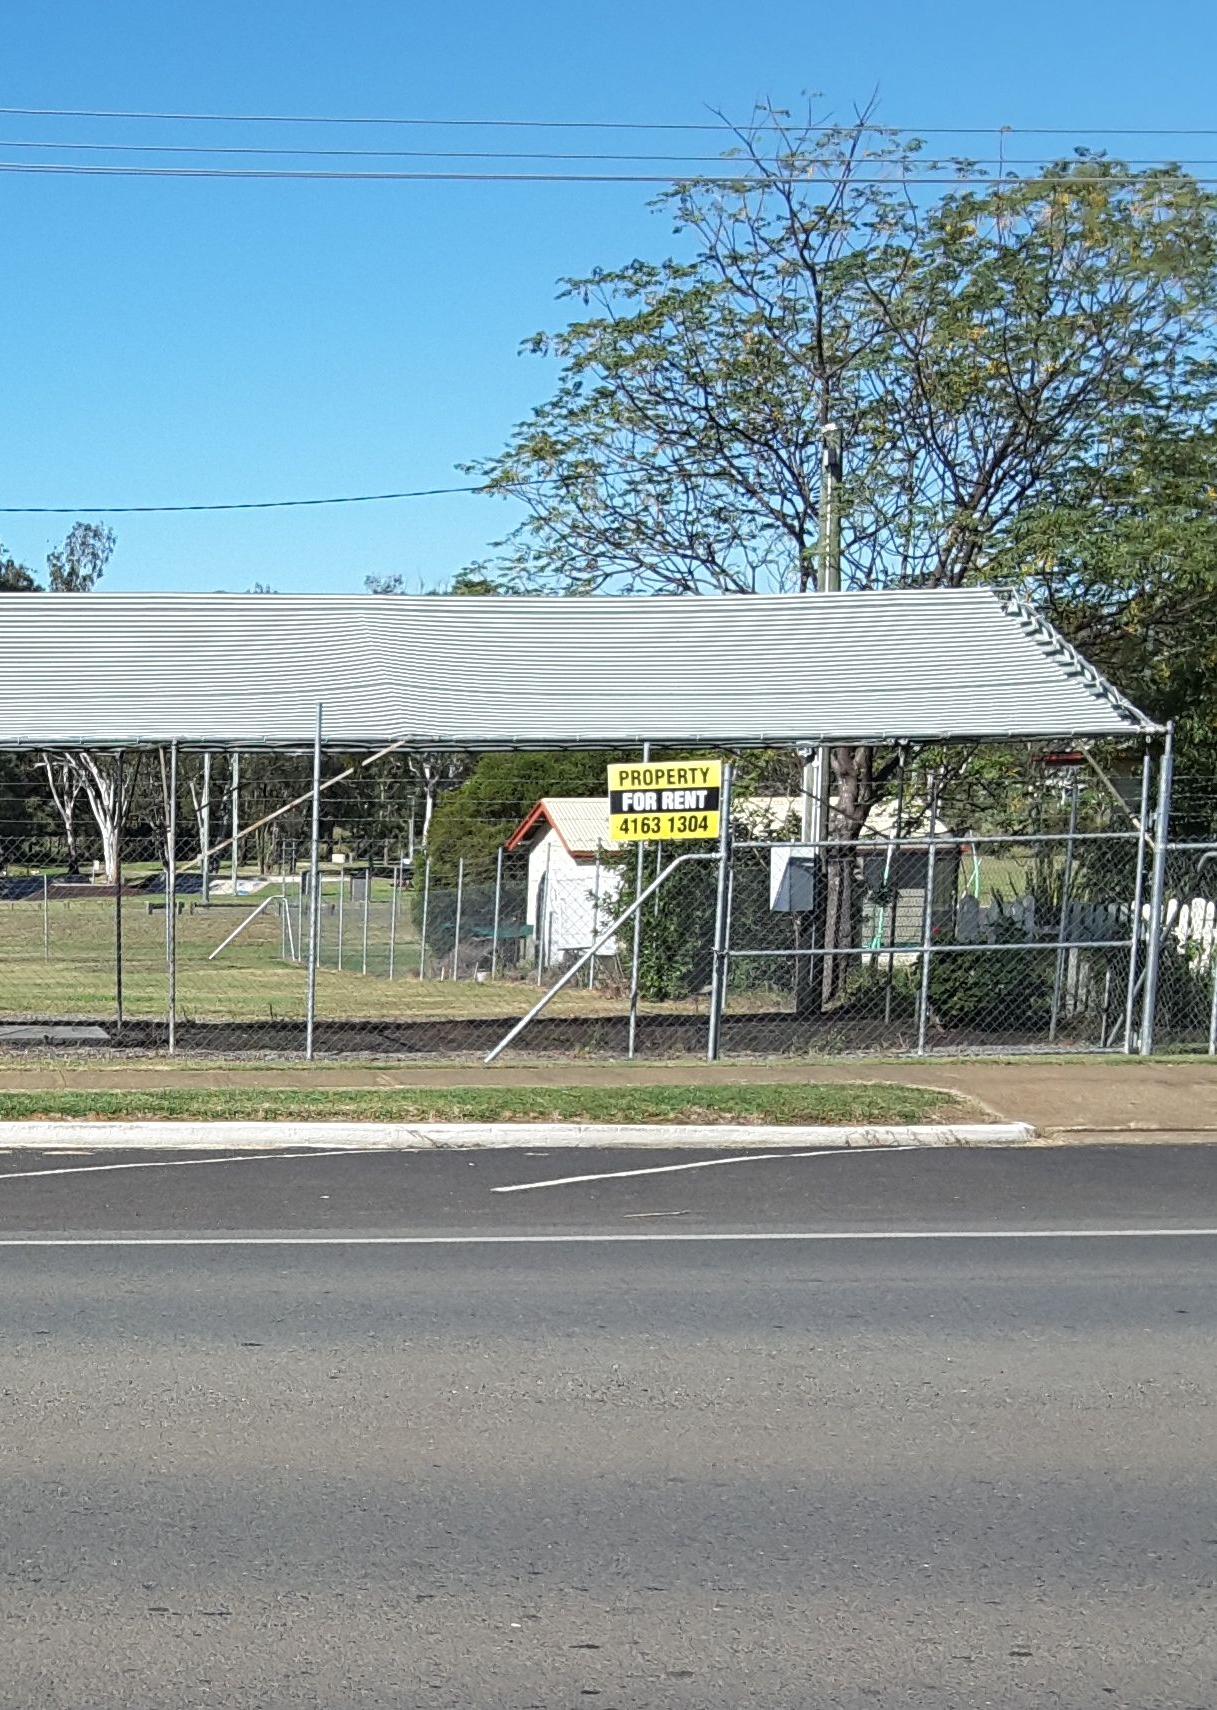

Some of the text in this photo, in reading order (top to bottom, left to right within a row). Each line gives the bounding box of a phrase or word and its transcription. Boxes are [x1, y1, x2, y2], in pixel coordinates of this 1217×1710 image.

[619, 767, 710, 786] PROPERTY
[622, 790, 707, 811] FOR RENT
[619, 815, 709, 834] 4163 1304
